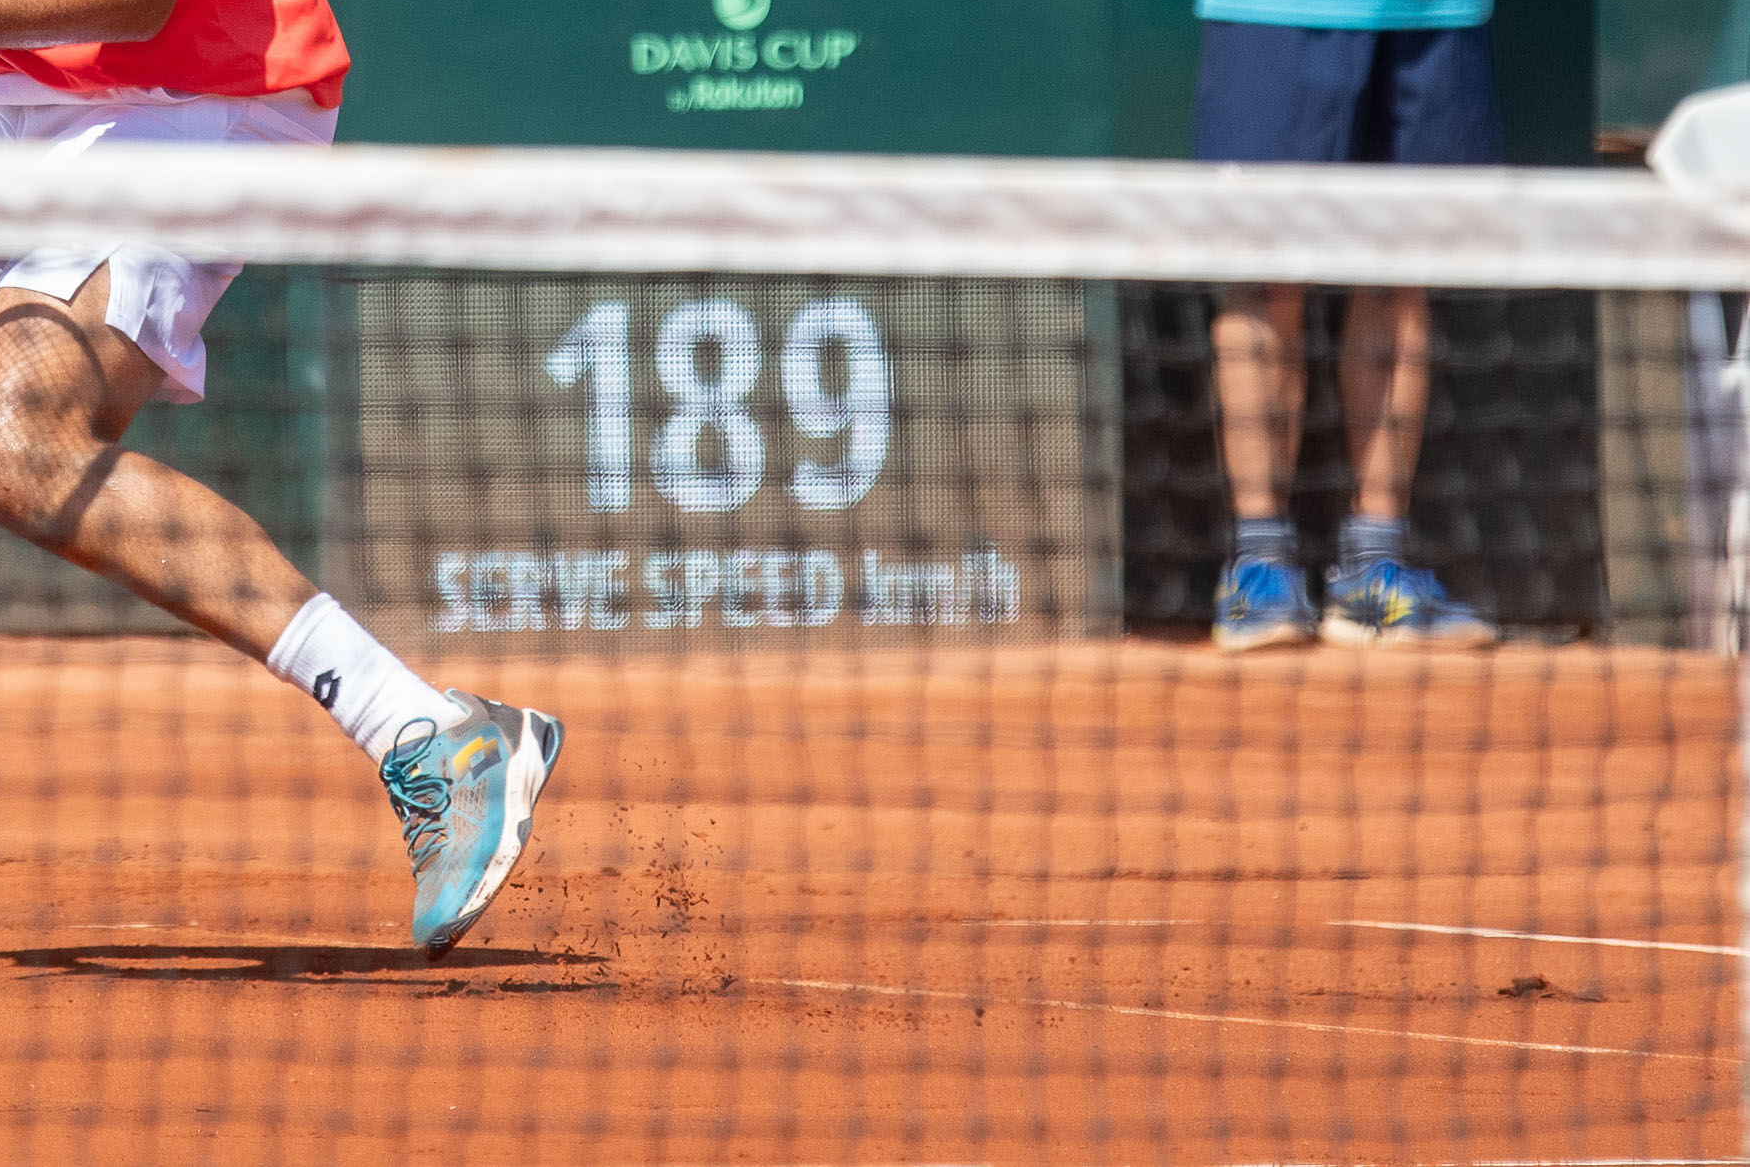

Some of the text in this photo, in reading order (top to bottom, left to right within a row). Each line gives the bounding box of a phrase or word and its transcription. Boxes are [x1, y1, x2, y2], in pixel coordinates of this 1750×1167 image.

[631, 30, 859, 73] DAVIS CUP
[690, 76, 804, 111] Rakuten
[543, 297, 893, 514] 189
[428, 550, 630, 632] SERVE
[642, 549, 844, 629] SPEED
